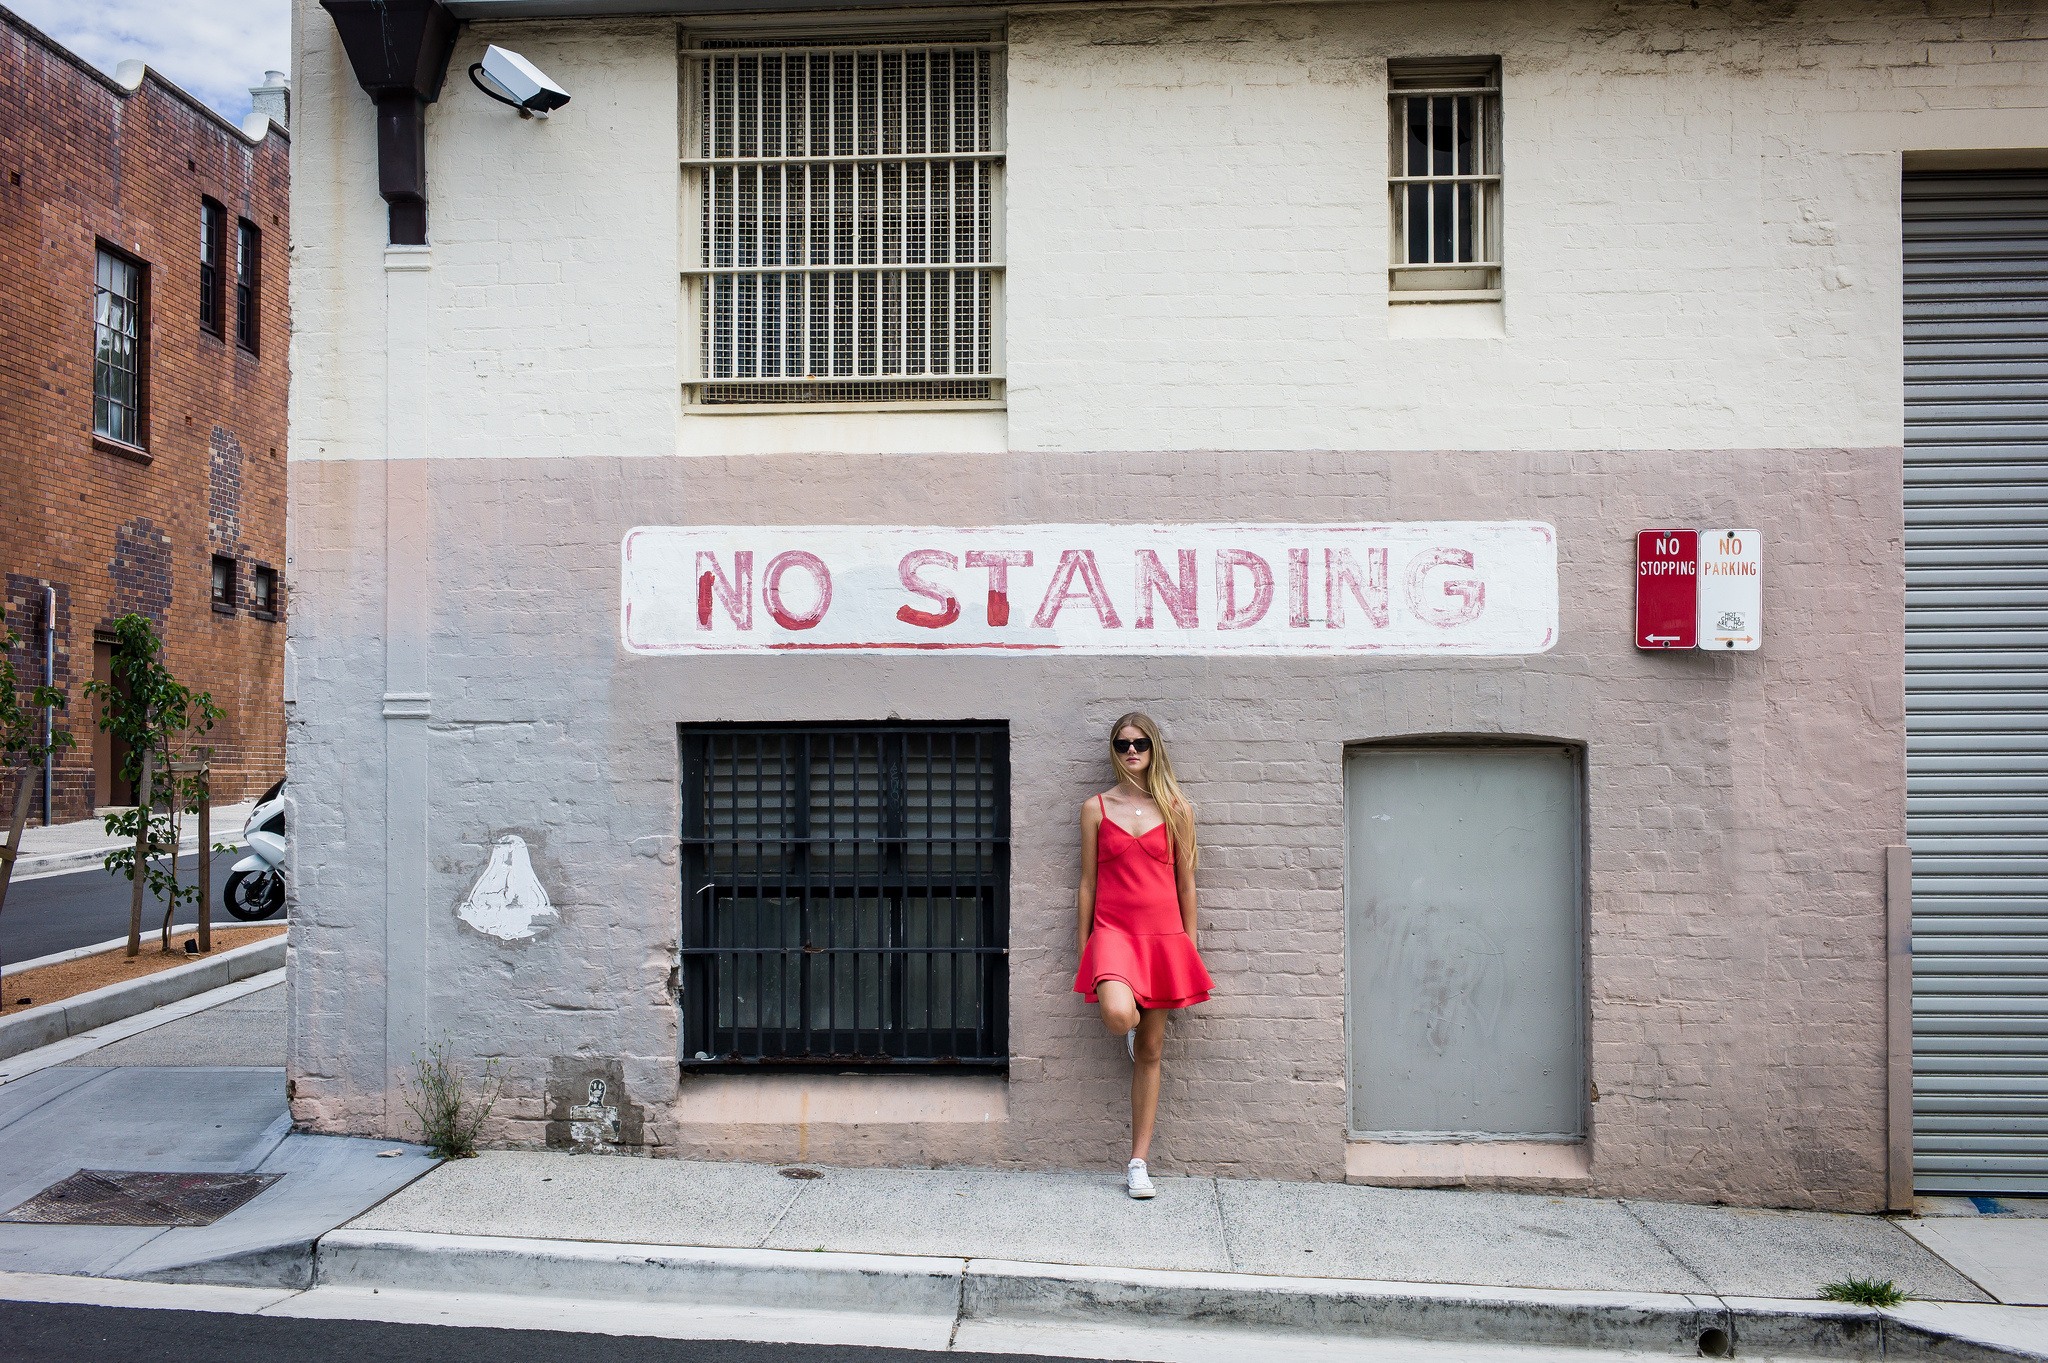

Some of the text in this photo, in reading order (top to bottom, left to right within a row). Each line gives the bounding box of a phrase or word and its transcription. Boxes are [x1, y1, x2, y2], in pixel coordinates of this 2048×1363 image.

[1656, 538, 1680, 555] NO
[1719, 538, 1742, 555] NO
[1640, 561, 1695, 575] STOPPING
[1704, 561, 1756, 576] PARKING
[696, 547, 1486, 631] NO STANDING
